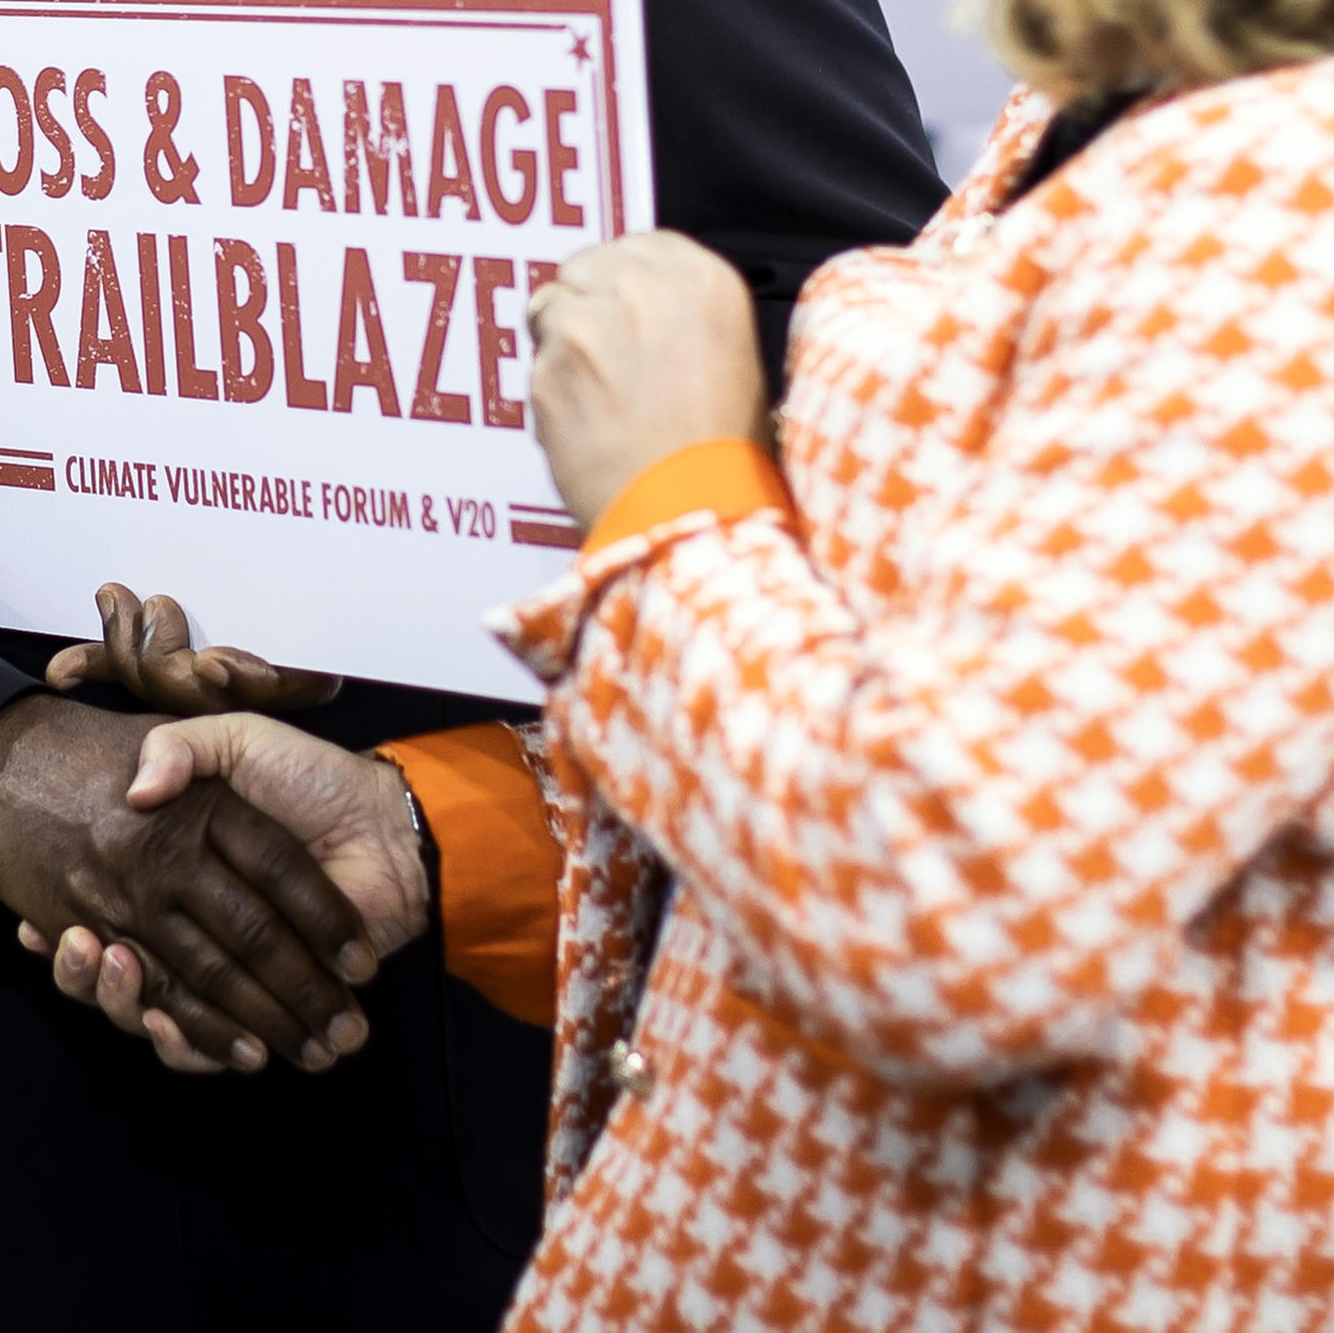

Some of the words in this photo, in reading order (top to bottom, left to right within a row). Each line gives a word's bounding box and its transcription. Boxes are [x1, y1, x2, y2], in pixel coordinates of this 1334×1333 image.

[144, 70, 202, 206] &
[223, 73, 586, 229] DAMAGE
[65, 455, 159, 501] CLIMATE
[164, 464, 314, 519] VULNERABLE
[321, 482, 412, 530] FORUM
[421, 494, 439, 534] &
[446, 496, 497, 540] V20
